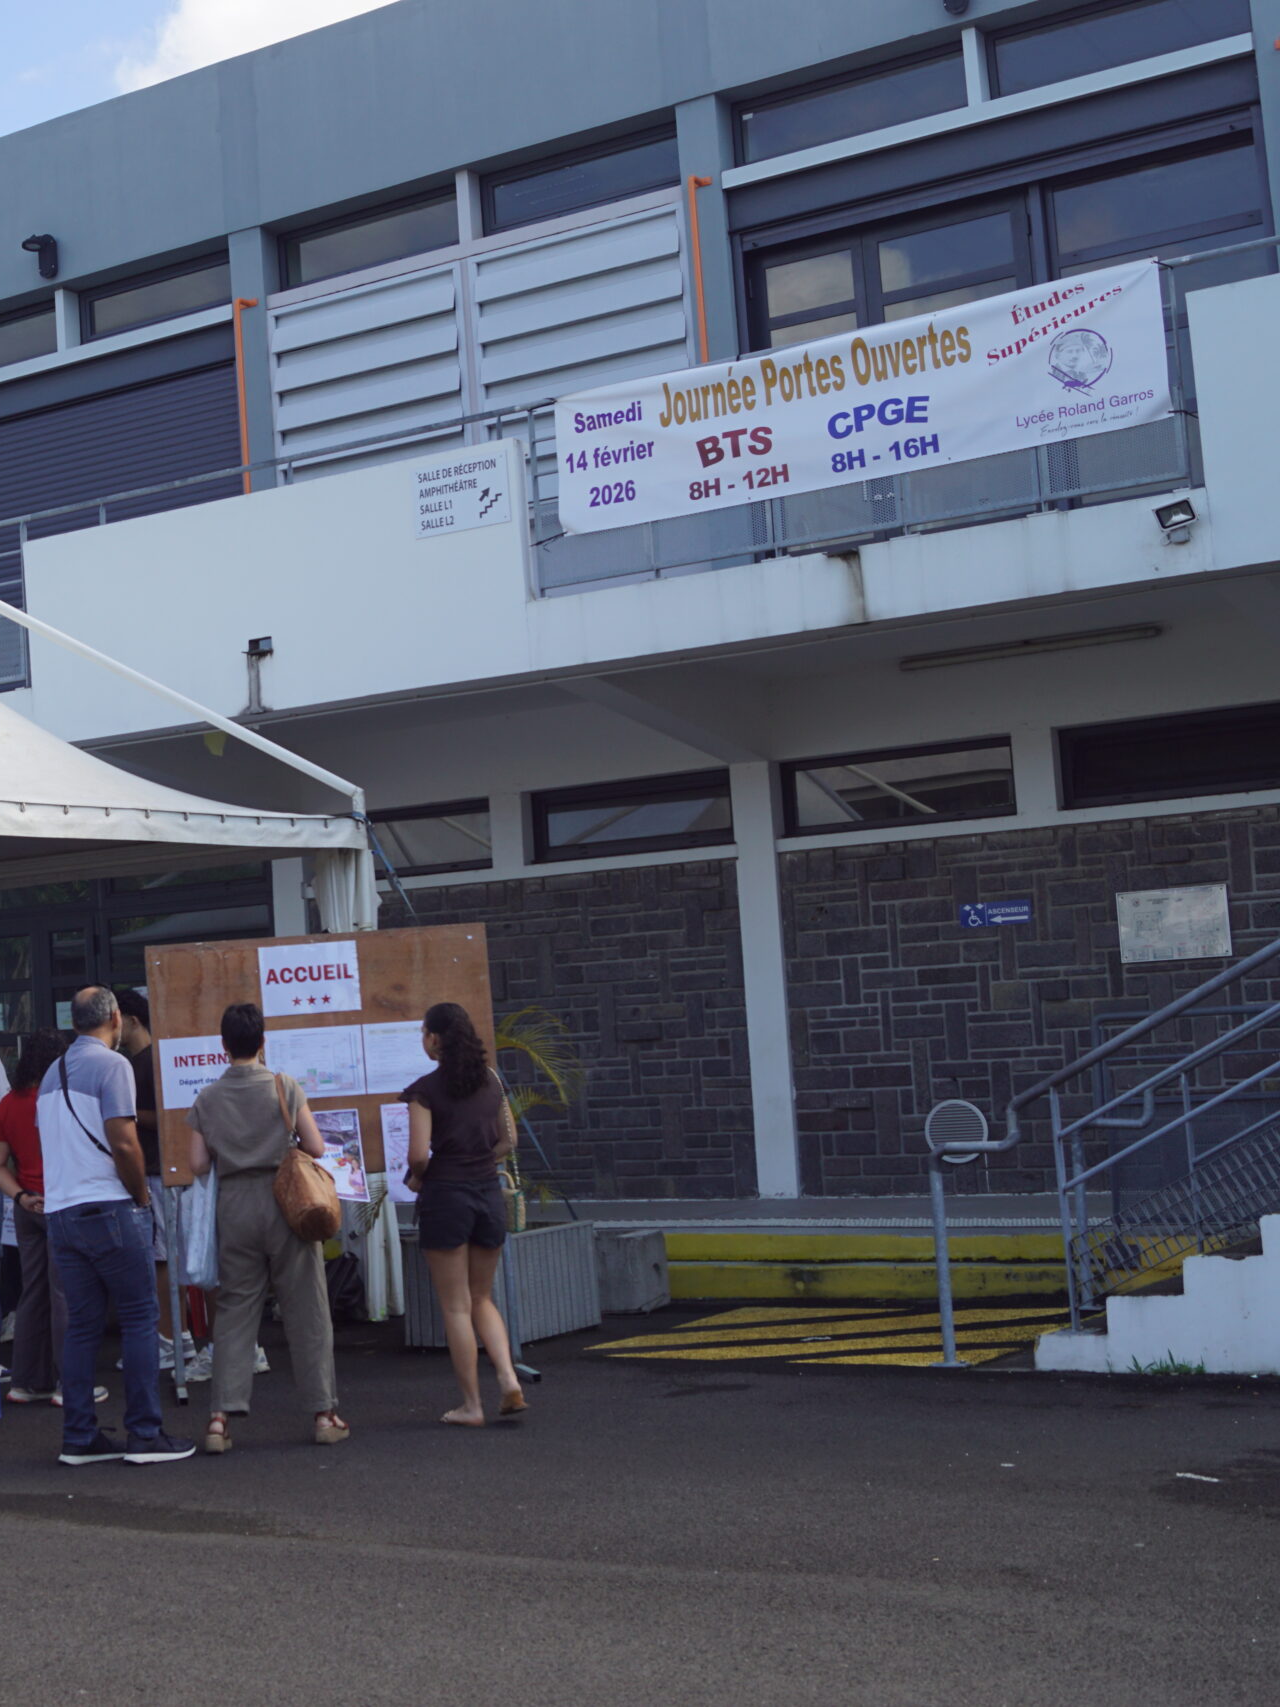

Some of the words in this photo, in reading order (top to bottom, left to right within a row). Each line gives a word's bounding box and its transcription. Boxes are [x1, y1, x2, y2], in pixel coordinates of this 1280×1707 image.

[1010, 283, 1085, 326] Études
[986, 285, 1123, 366] Supérieures
[659, 366, 756, 428] Journée
[760, 349, 846, 406] Portes
[851, 321, 971, 386] Ouvertes
[574, 401, 643, 434] Samedi
[827, 396, 930, 440] CPGE
[1016, 411, 1055, 430] Lycée
[1058, 398, 1105, 419] Roland
[1109, 389, 1154, 408] Garros
[565, 450, 588, 474] 14
[593, 440, 655, 469] février
[696, 426, 773, 469] BTS
[831, 448, 866, 473] 8H
[888, 433, 940, 461] 16H
[417, 469, 441, 483] SALLE
[442, 467, 452, 479] DE
[453, 458, 496, 476] RÉCEPTION
[689, 477, 720, 501] 8H
[742, 463, 790, 490] 12H
[419, 479, 477, 499] AMPHITHÉÂTRE
[589, 480, 636, 508] 2026
[420, 501, 443, 515] SALLE
[444, 499, 453, 511] L1
[421, 517, 444, 531] SALLE
[445, 515, 454, 526] L2
[987, 906, 1029, 915] ASCENSEUR
[265, 963, 354, 985] ACCUEIL
[174, 1052, 231, 1068] INTERN
